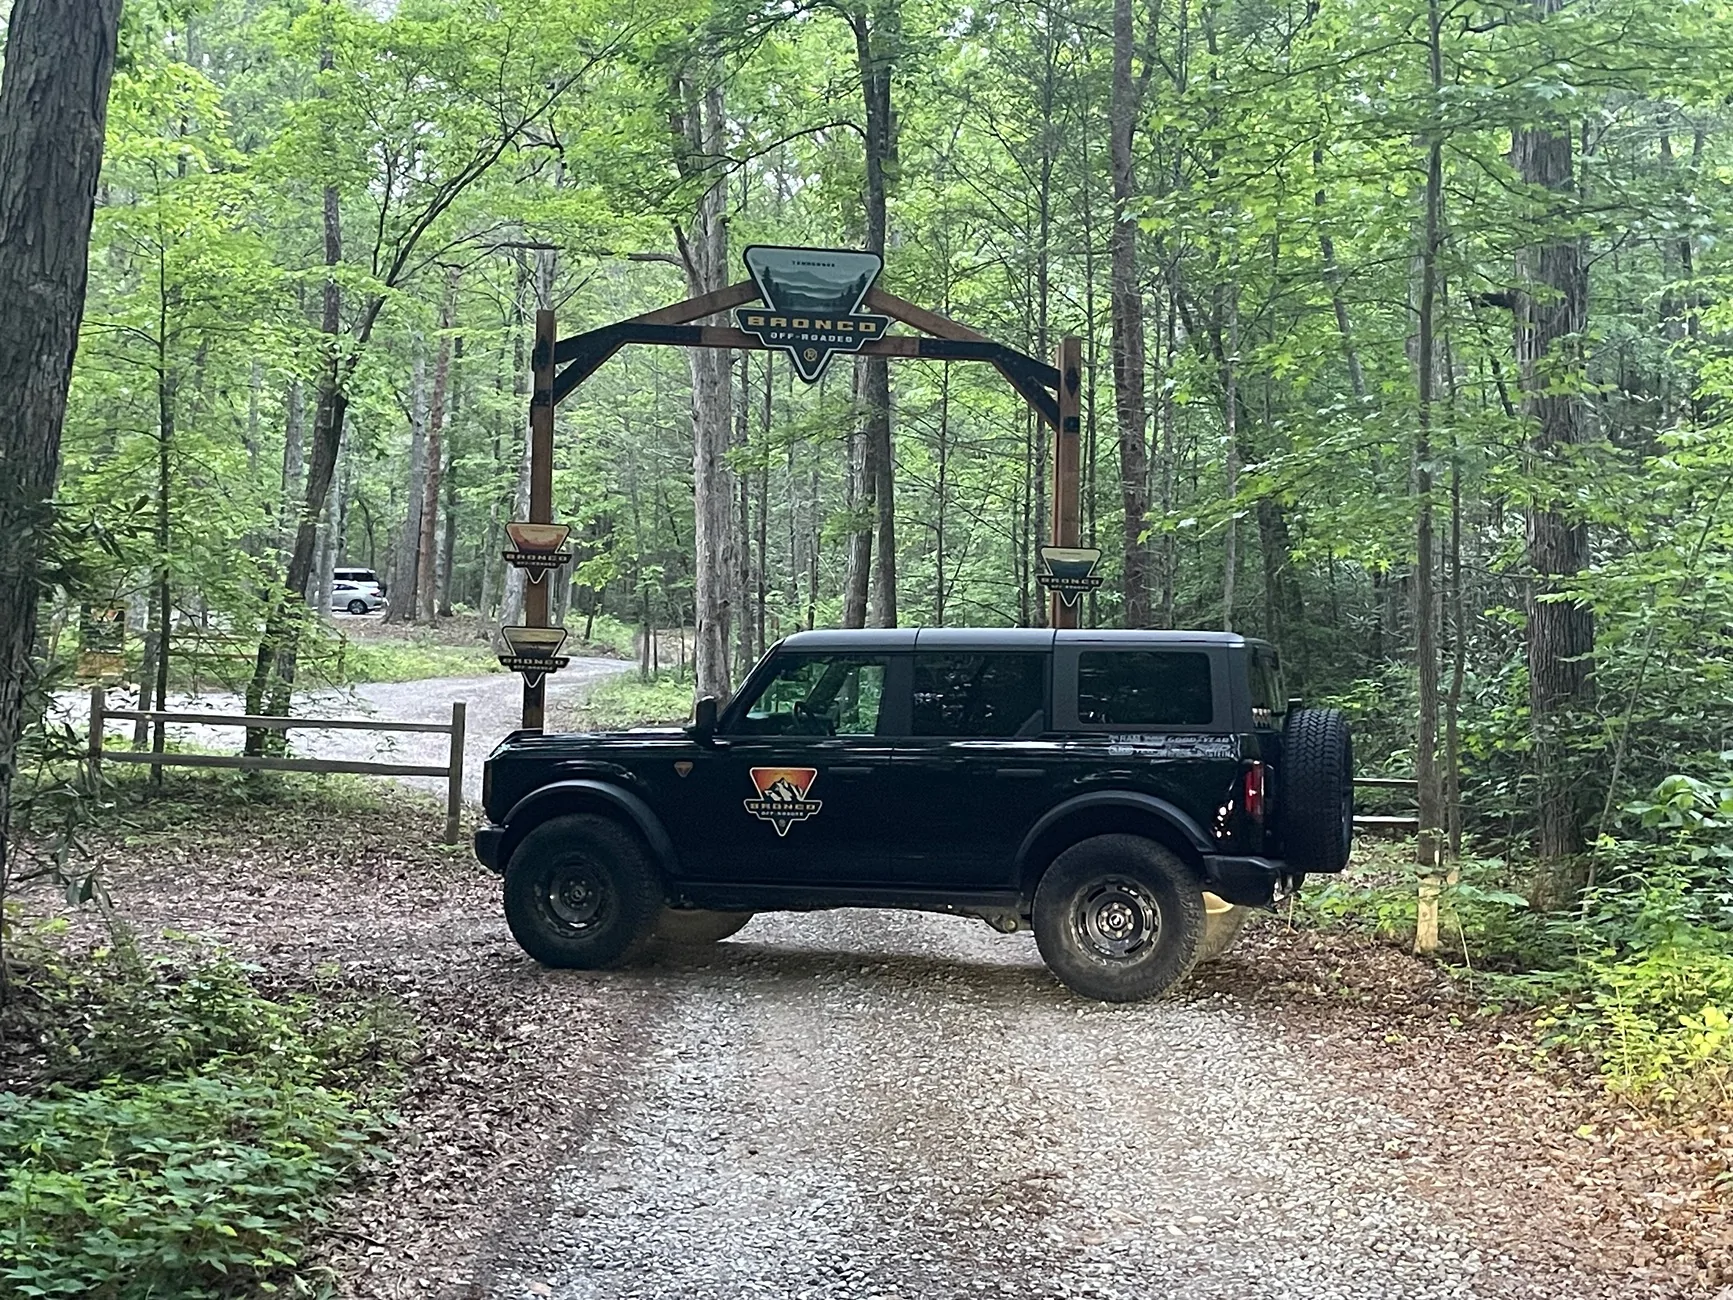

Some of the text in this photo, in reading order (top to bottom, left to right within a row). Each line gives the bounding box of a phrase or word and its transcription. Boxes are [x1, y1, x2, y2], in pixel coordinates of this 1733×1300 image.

[747, 316, 876, 332] BRONCO
[506, 553, 567, 561] BRONCO
[1041, 577, 1099, 585] BRONCO
